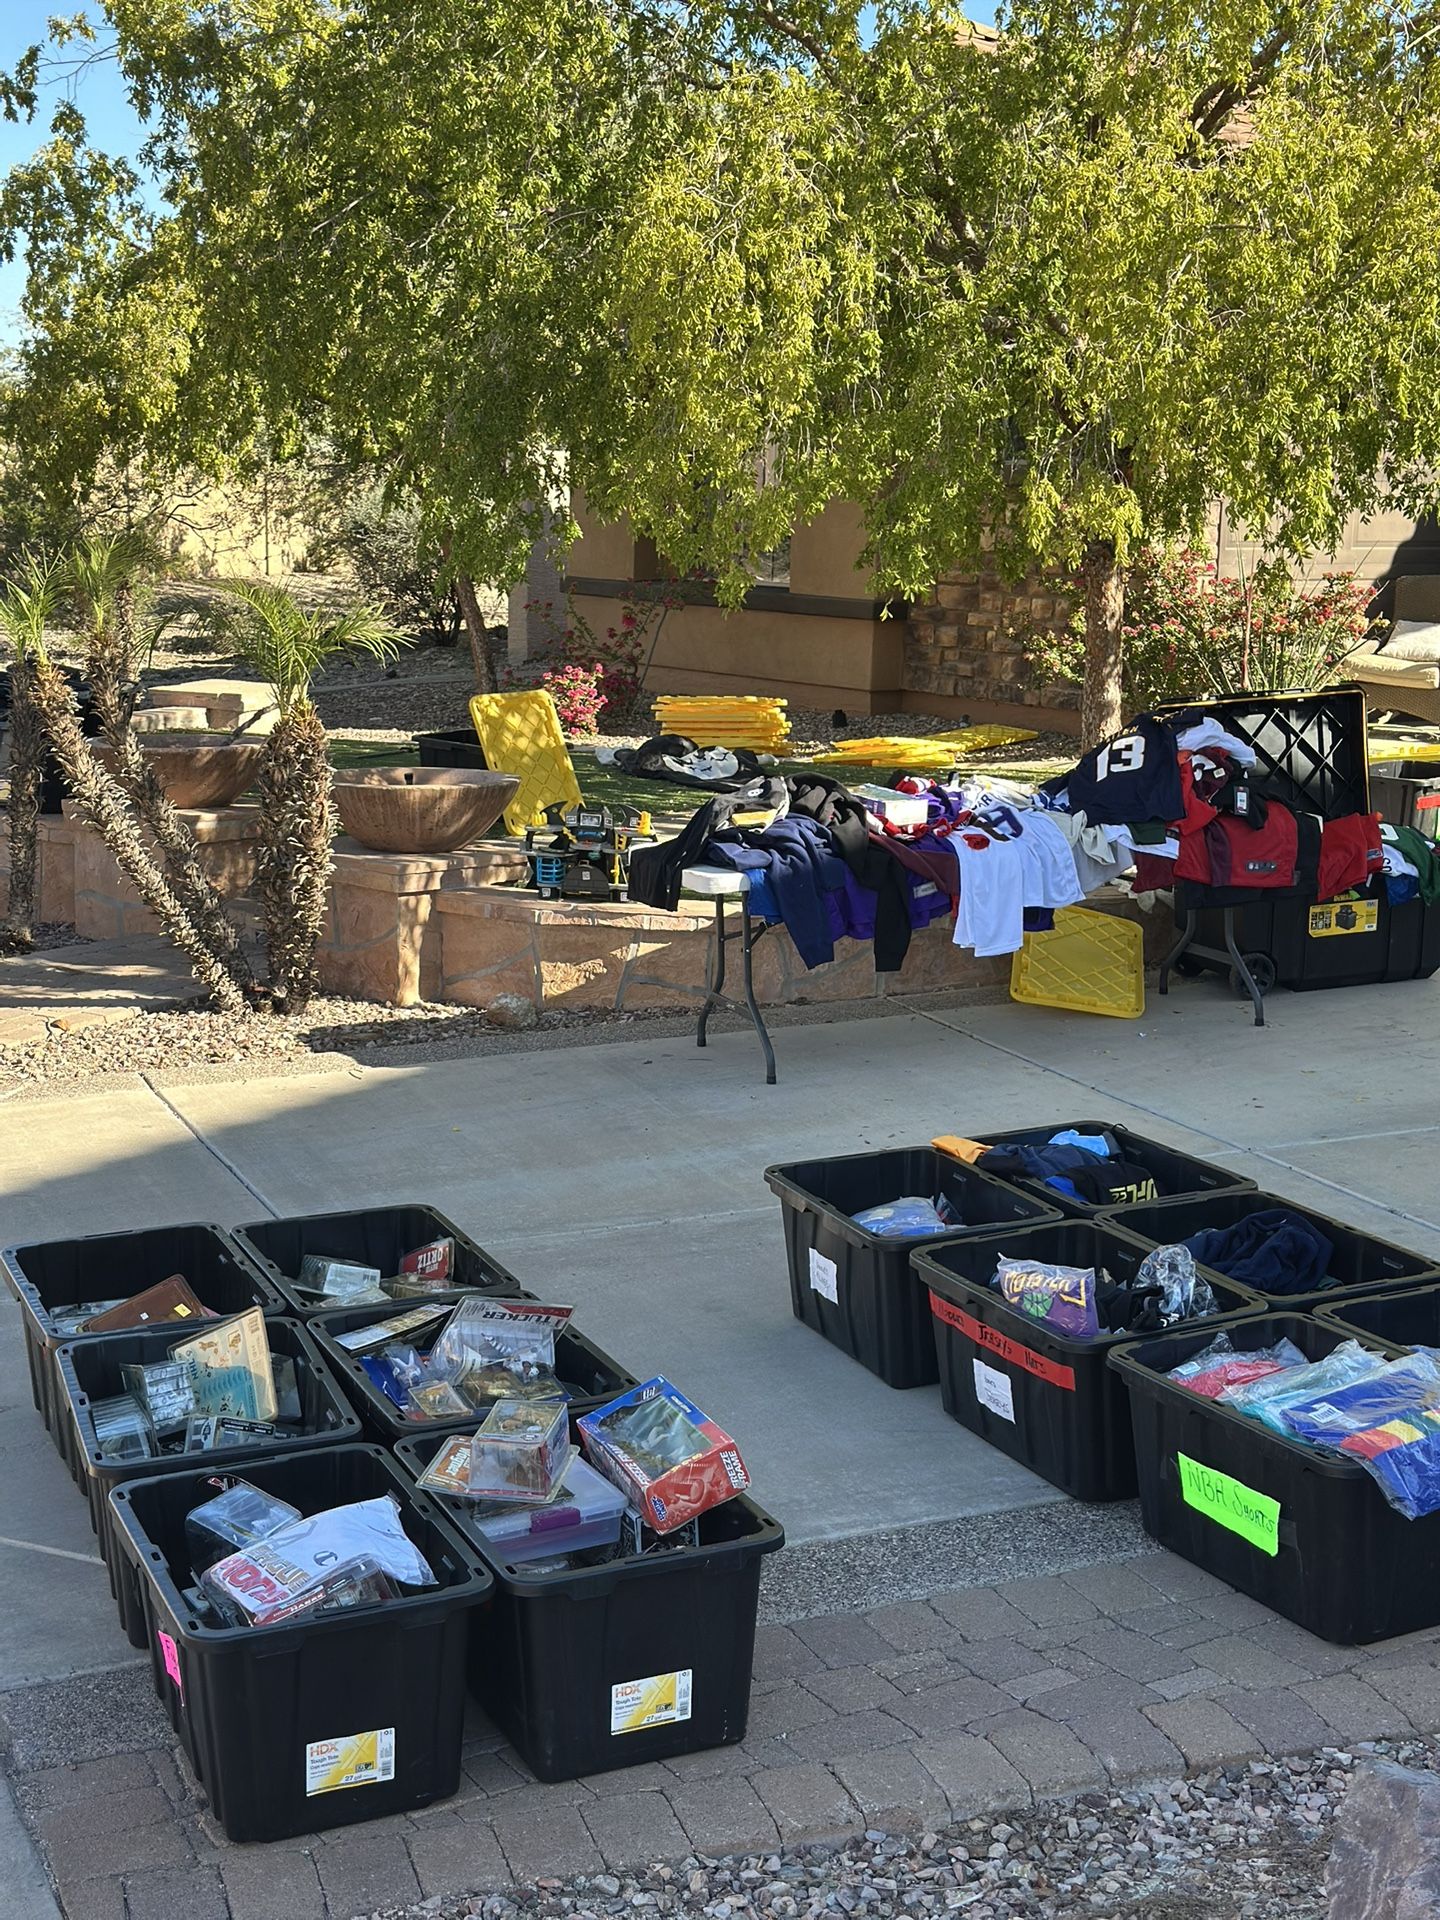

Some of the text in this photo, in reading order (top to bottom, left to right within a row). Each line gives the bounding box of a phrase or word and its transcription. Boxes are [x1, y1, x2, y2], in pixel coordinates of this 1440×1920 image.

[1096, 735, 1146, 783] 13
[417, 1247, 444, 1270] ORTIZ
[482, 1311, 553, 1324] TUCKER
[1187, 1462, 1228, 1507] NBA
[615, 1683, 641, 1698] HDX
[310, 1742, 338, 1757] HDX
